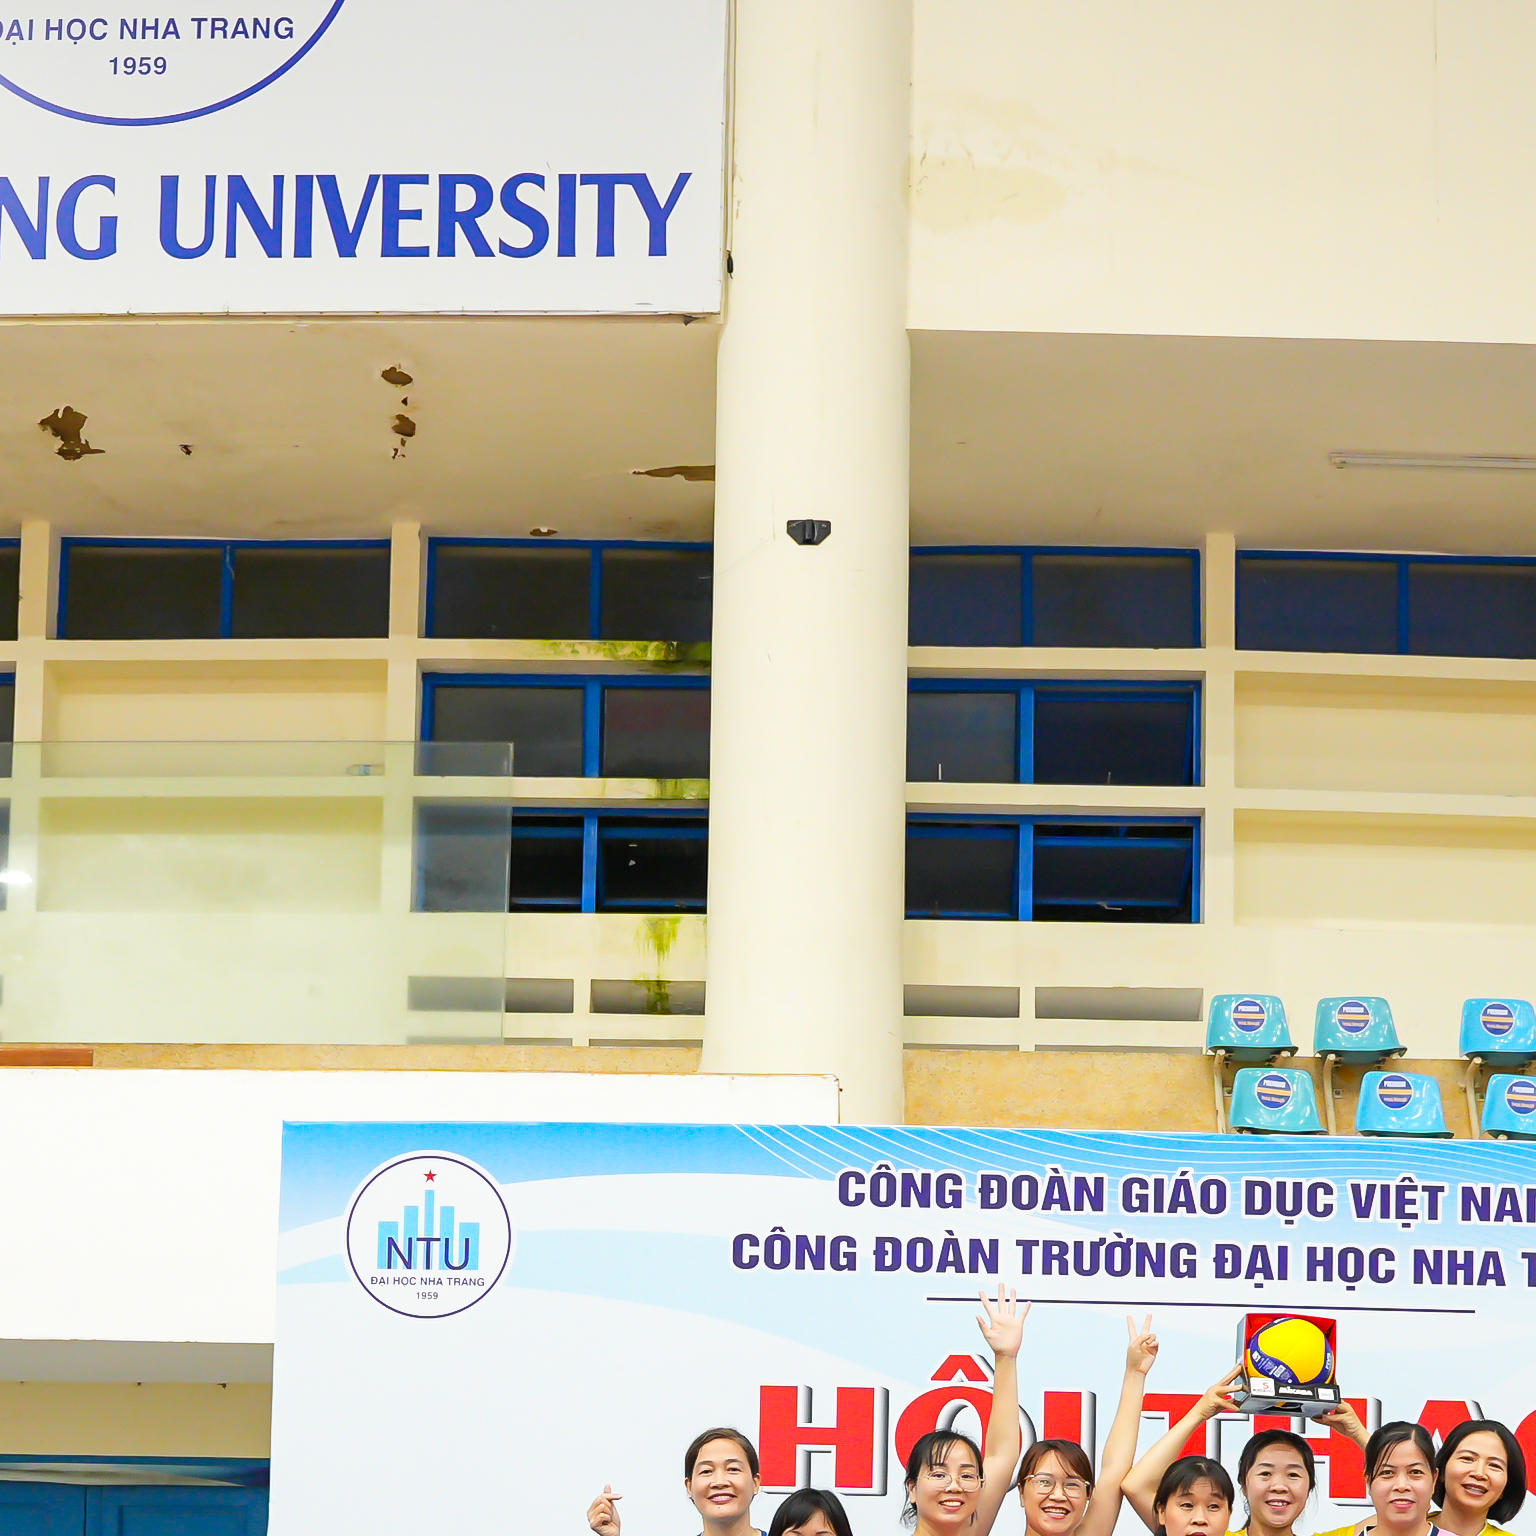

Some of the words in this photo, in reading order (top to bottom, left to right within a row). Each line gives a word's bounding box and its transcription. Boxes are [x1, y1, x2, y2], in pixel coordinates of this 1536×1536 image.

[45, 18, 108, 45] HỌC
[119, 17, 181, 40] NHA
[190, 16, 294, 40] TRANG
[109, 56, 167, 75] 1959
[159, 172, 693, 260] UNIVERSITY
[838, 1164, 963, 1209] CÔNG
[978, 1167, 1104, 1212] ĐOÀN
[1122, 1170, 1227, 1215] GIÁO
[1244, 1179, 1334, 1225] DỤC
[1350, 1176, 1445, 1229] VIỆT
[387, 1236, 470, 1271] NTU
[732, 1226, 857, 1272] CÔNG
[872, 1229, 999, 1274] ĐOÀN
[1015, 1232, 1197, 1279] TRƯỜNG
[1212, 1243, 1288, 1289] ĐẠI
[1306, 1246, 1395, 1291] HỌC
[1413, 1249, 1506, 1287] NHA
[370, 1276, 389, 1287] ĐẠI
[393, 1276, 416, 1287] HỌC
[420, 1277, 443, 1286] NHA
[447, 1277, 485, 1286] TRANG
[416, 1292, 438, 1300] 1959
